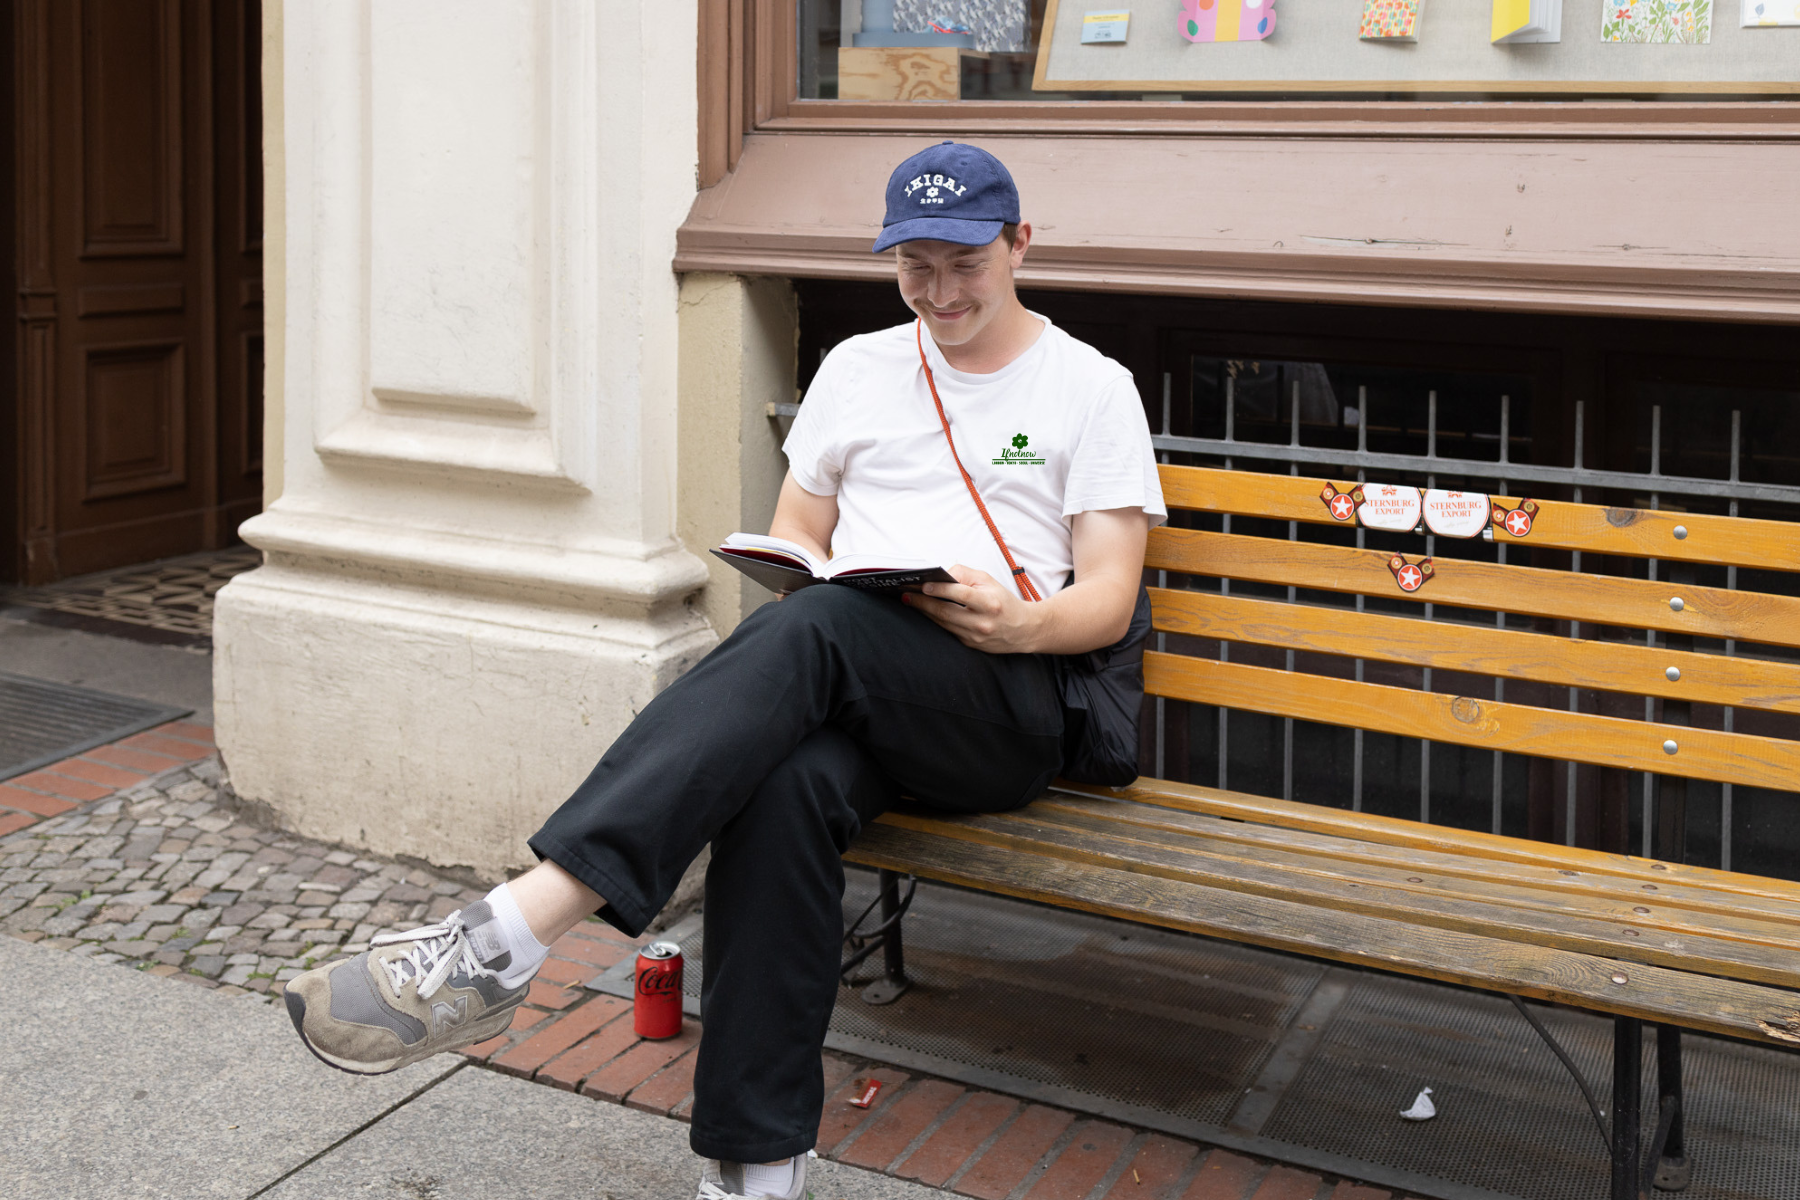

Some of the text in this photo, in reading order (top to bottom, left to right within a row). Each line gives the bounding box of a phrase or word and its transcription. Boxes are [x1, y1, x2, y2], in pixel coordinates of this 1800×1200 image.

[904, 174, 967, 197] IKIGAI
[1365, 499, 1415, 507] STERNBURG
[1430, 501, 1481, 510] STERNBURG
[1441, 510, 1472, 518] EXPORT
[431, 995, 468, 1038] N
